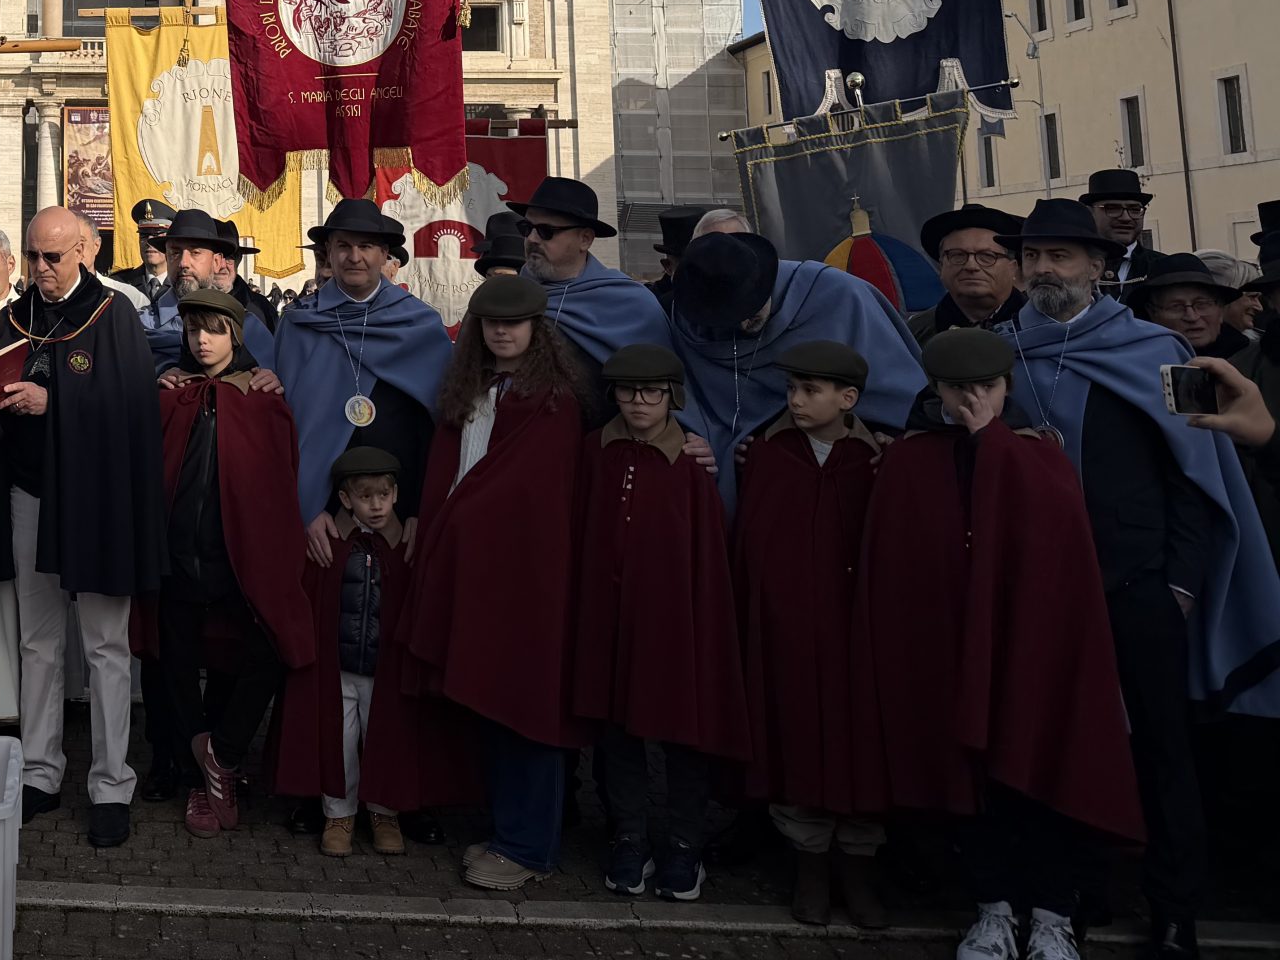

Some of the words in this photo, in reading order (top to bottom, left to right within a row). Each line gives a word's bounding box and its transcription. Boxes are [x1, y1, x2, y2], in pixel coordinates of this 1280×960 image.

[260, 12, 293, 59] PRIORI
[396, 0, 423, 52] ABATE
[182, 87, 232, 103] RIONE
[288, 91, 297, 104] S.
[301, 89, 333, 103] MARIA
[335, 87, 365, 101] DEGLI
[369, 86, 404, 100] ANGELI
[335, 104, 361, 118] ASSISI
[185, 177, 234, 193] FORNACI
